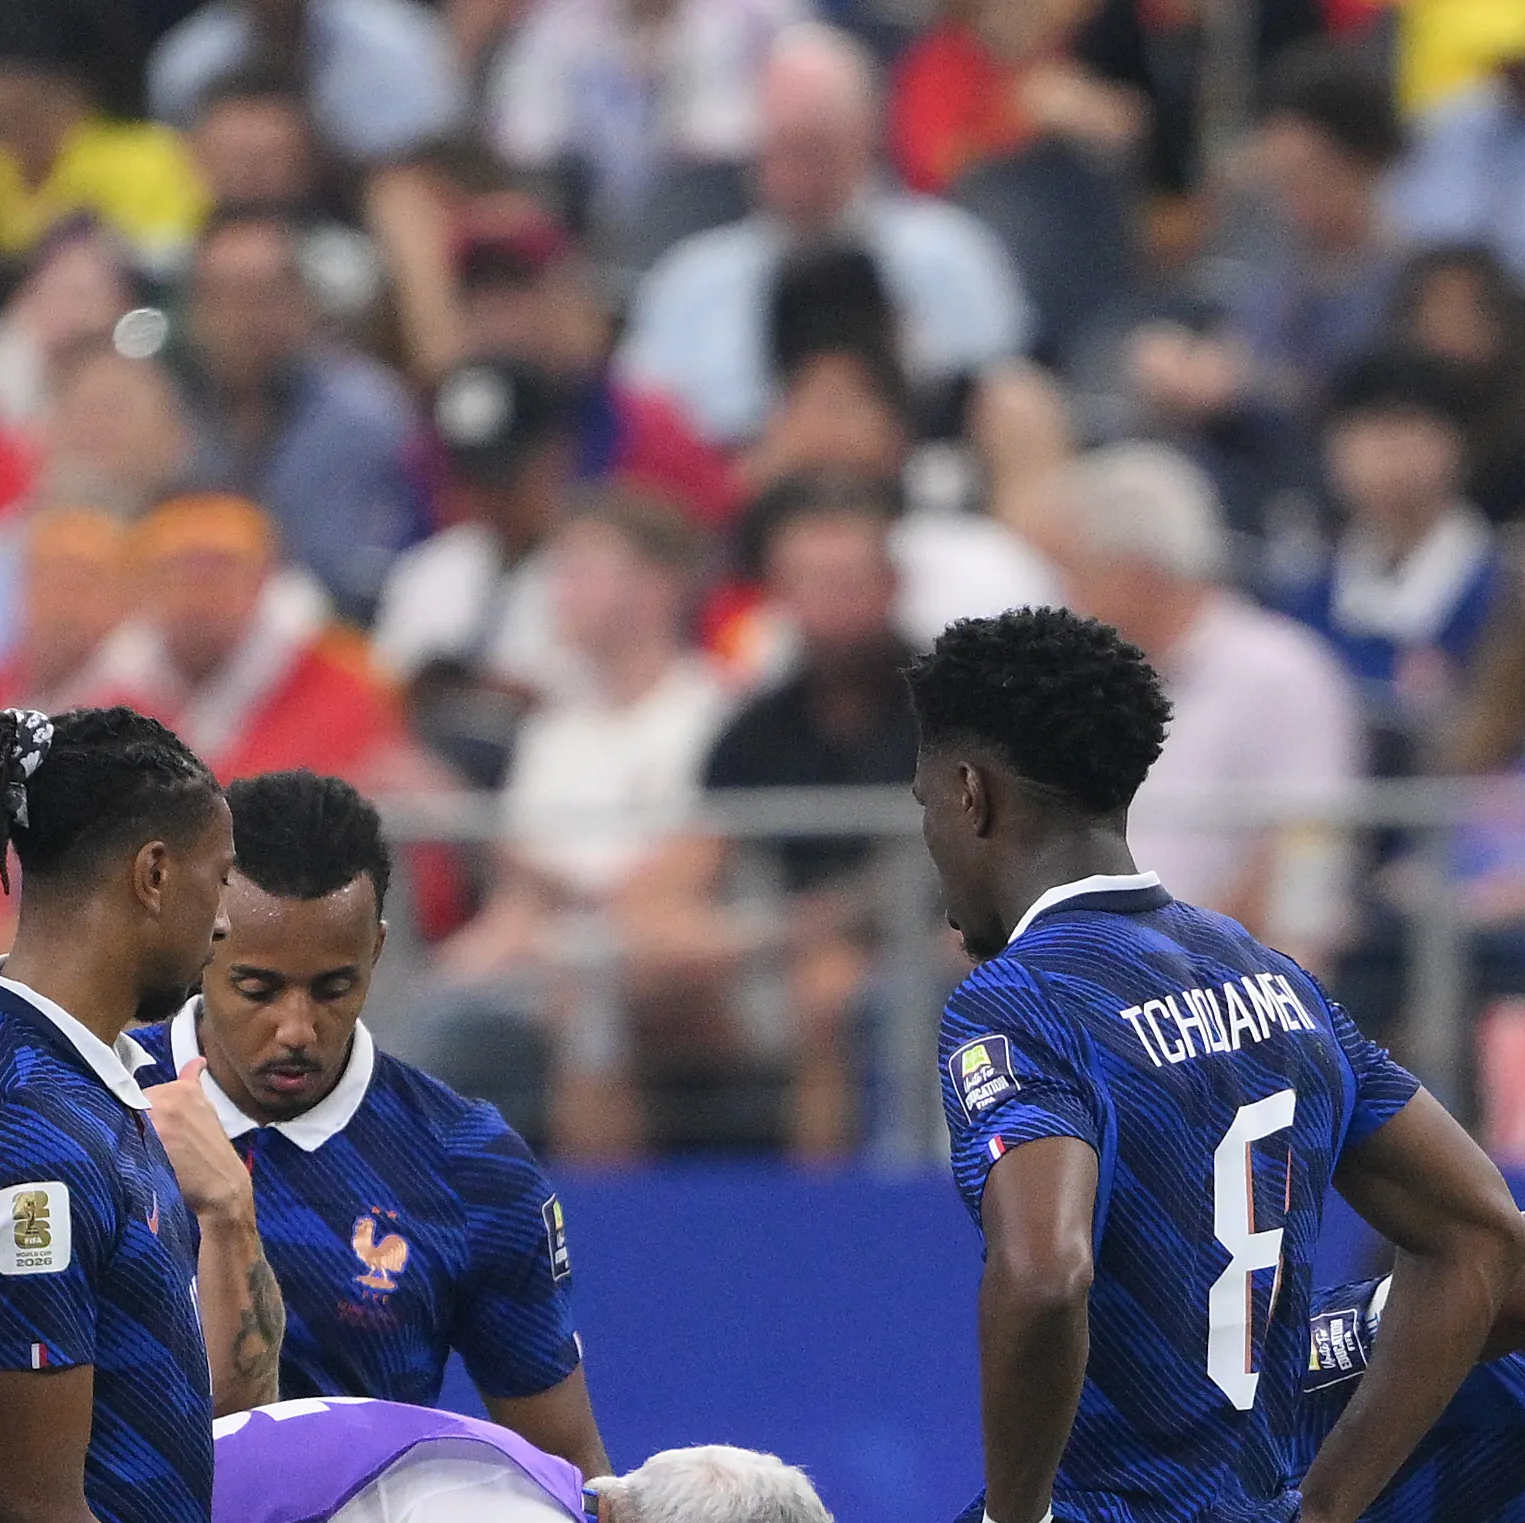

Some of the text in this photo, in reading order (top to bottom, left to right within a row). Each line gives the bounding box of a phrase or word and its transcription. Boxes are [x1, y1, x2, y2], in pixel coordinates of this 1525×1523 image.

[24, 1237, 43, 1245] FIFA
[16, 1250, 38, 1258] WORLD
[16, 1257, 53, 1268] 2026
[1330, 1318, 1353, 1371] EDUCATION
